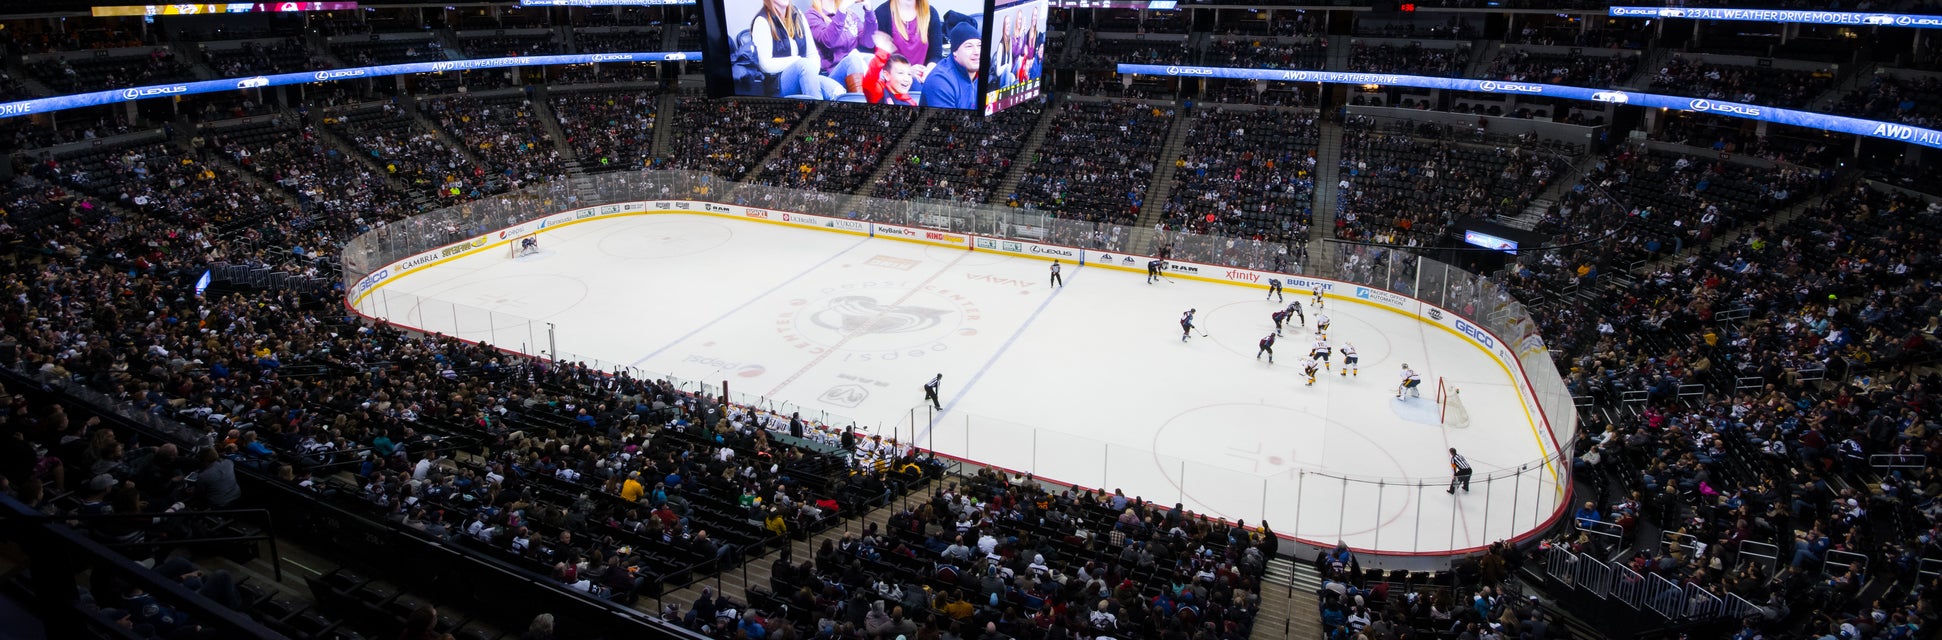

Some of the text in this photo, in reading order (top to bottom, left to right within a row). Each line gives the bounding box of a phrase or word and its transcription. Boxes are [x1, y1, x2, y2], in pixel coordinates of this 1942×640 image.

[1687, 9, 1701, 18] 23
[1702, 9, 1722, 19] ALL
[1725, 10, 1778, 21] WEATHER
[1779, 11, 1811, 22] DRIVE
[1812, 12, 1861, 24] MODELS
[431, 56, 531, 71] AWD ALL WEATHER DRIVE
[329, 69, 365, 79] LEXUS
[1282, 71, 1307, 80] AWD
[1313, 72, 1328, 81] ALL
[1330, 73, 1371, 83] WEATHER
[1371, 74, 1398, 84] DRIVE
[139, 85, 188, 96] LEXUS
[1497, 82, 1543, 93] LEXUS
[1711, 103, 1760, 117] LEXUS
[1873, 123, 1942, 145] AWD ALL
[507, 227, 525, 237] pepsi
[878, 226, 903, 235] KeyBank
[1041, 248, 1073, 257] LEXUS
[402, 253, 439, 270] CAMBRIA
[1171, 264, 1198, 272] RAM
[360, 269, 388, 292] GEICO
[1225, 269, 1260, 284] xfinity
[1287, 278, 1305, 287] BUD
[1369, 293, 1403, 307] AUTOMATION
[1370, 289, 1388, 298] PACIFIC
[1455, 319, 1493, 349] GEICO
